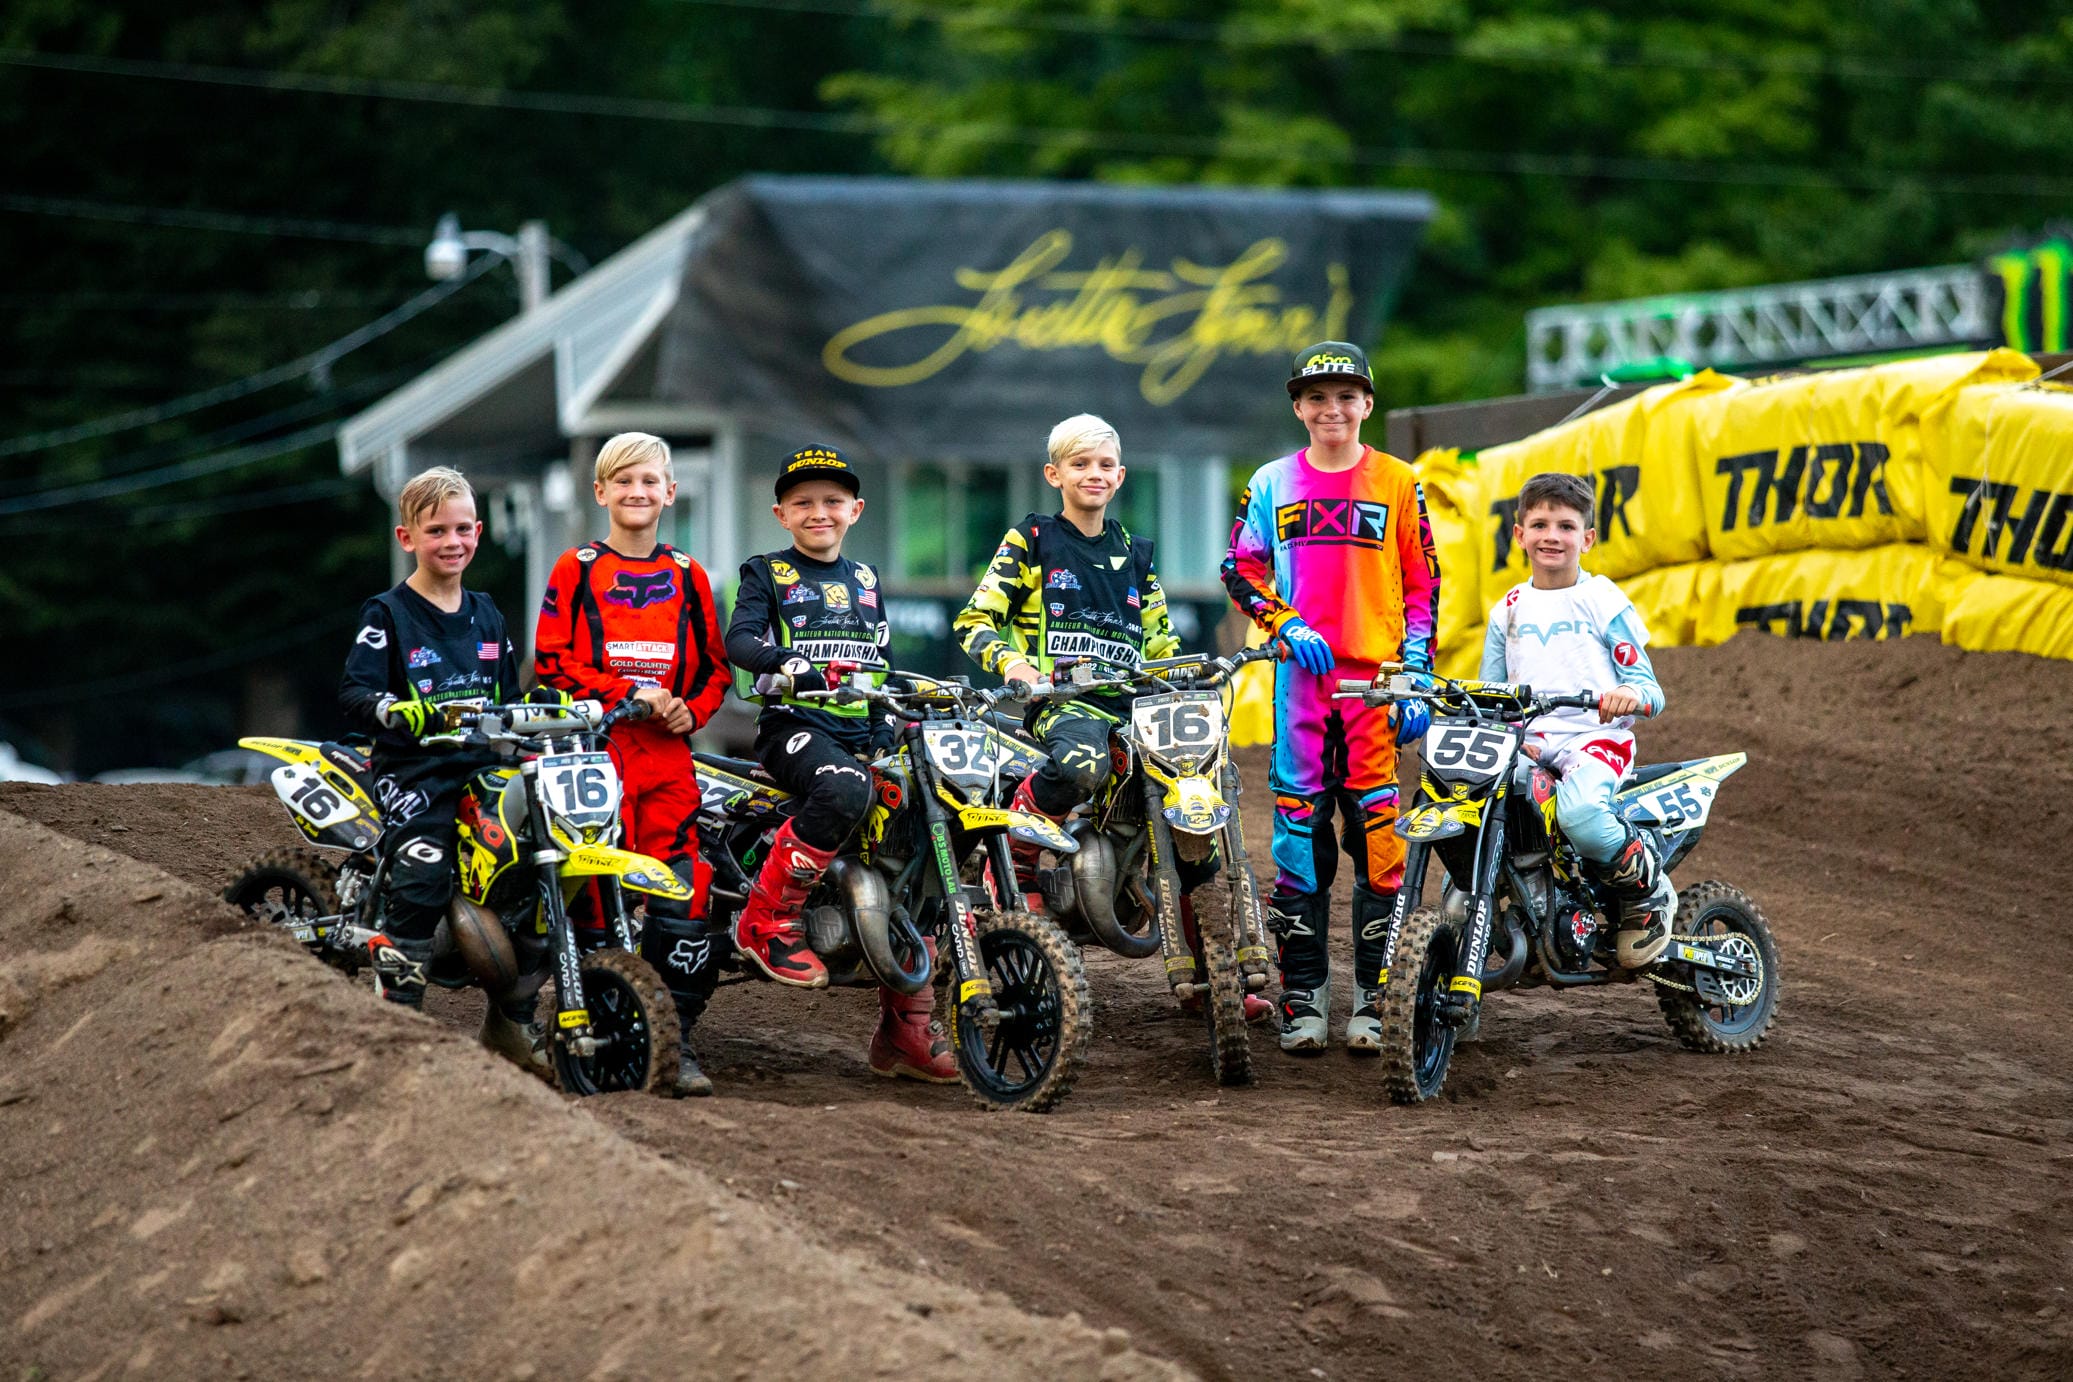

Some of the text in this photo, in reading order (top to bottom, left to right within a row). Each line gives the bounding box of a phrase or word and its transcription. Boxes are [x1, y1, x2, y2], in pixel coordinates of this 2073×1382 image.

[1302, 363, 1356, 377] ELITE
[787, 457, 847, 473] DUNLOP
[794, 449, 837, 460] TEAM
[1715, 442, 1895, 533] THOR
[1277, 500, 1389, 541] FXR
[1949, 476, 2073, 571] THO
[794, 630, 822, 639] AMATEUR
[1050, 621, 1082, 630] AMATEUR
[1618, 645, 1633, 665] 7
[1150, 704, 1210, 747] 16
[940, 734, 990, 773] 32
[1433, 729, 1506, 770] 55
[290, 777, 341, 821] 16
[557, 768, 608, 812] 16
[1656, 783, 1703, 821] 55
[940, 849, 953, 876] MOTO
[946, 877, 957, 895] LAB
[1159, 877, 1181, 956] DUNLOP
[1385, 893, 1406, 968] DUNLOP
[954, 900, 981, 977] DUNLOP
[1467, 900, 1487, 977] DUNLOP
[566, 929, 585, 1009] DUNLOP
